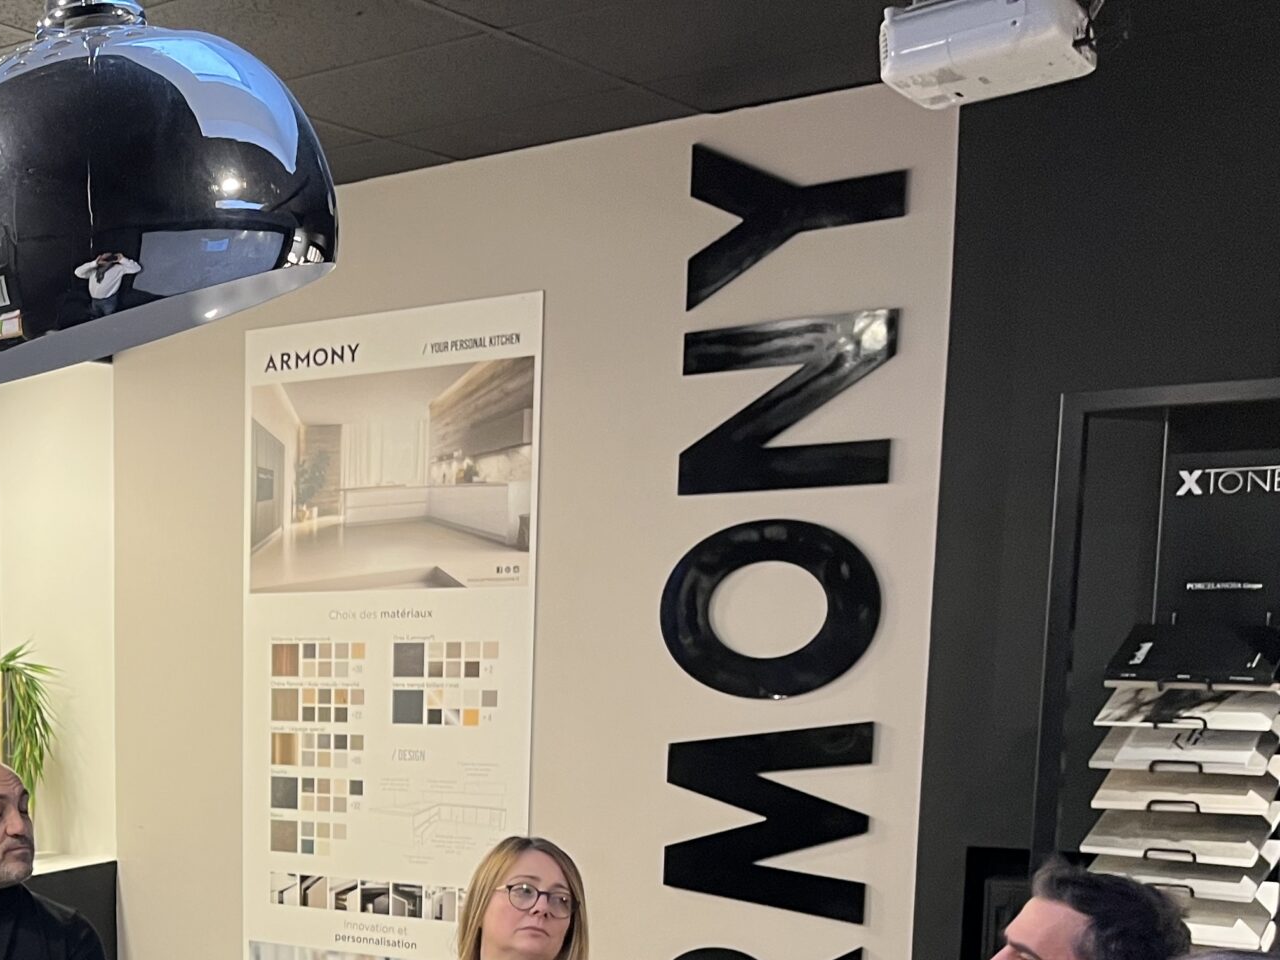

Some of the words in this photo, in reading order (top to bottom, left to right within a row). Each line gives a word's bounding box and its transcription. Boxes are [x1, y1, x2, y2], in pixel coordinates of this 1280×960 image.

[430, 341, 449, 354] YOUR
[450, 337, 486, 352] PERSONAL
[488, 333, 520, 347] KITCHEN
[264, 343, 360, 373] ARMONY
[328, 609, 357, 621] Choix
[359, 609, 377, 620] des
[380, 607, 433, 619] matériaux
[398, 748, 426, 761] DESIGN
[343, 919, 395, 934] Innovation
[397, 926, 408, 936] et
[334, 932, 417, 950] personnalisation
